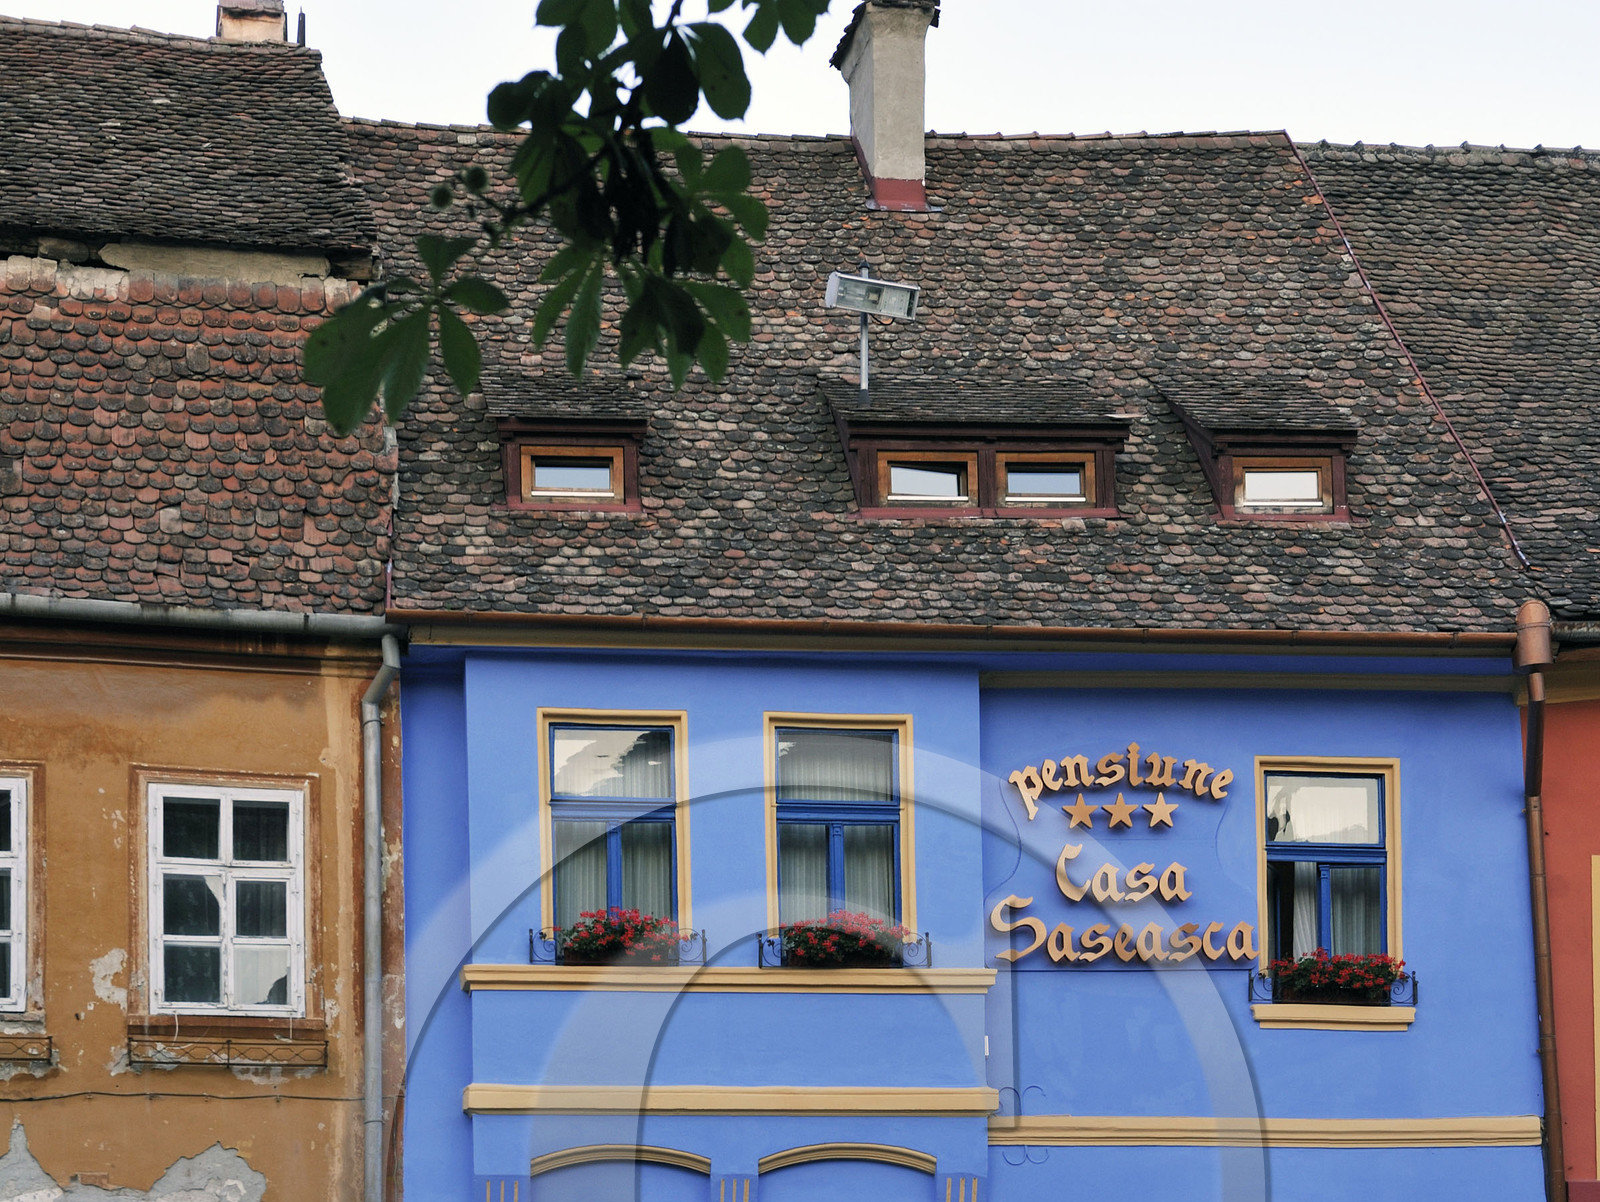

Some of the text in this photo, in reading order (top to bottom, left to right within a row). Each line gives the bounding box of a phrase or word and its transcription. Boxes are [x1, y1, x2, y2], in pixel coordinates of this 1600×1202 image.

[1008, 742, 1234, 820] pensiune
[1056, 843, 1193, 902] Casa
[990, 894, 1260, 962] Saseasca
